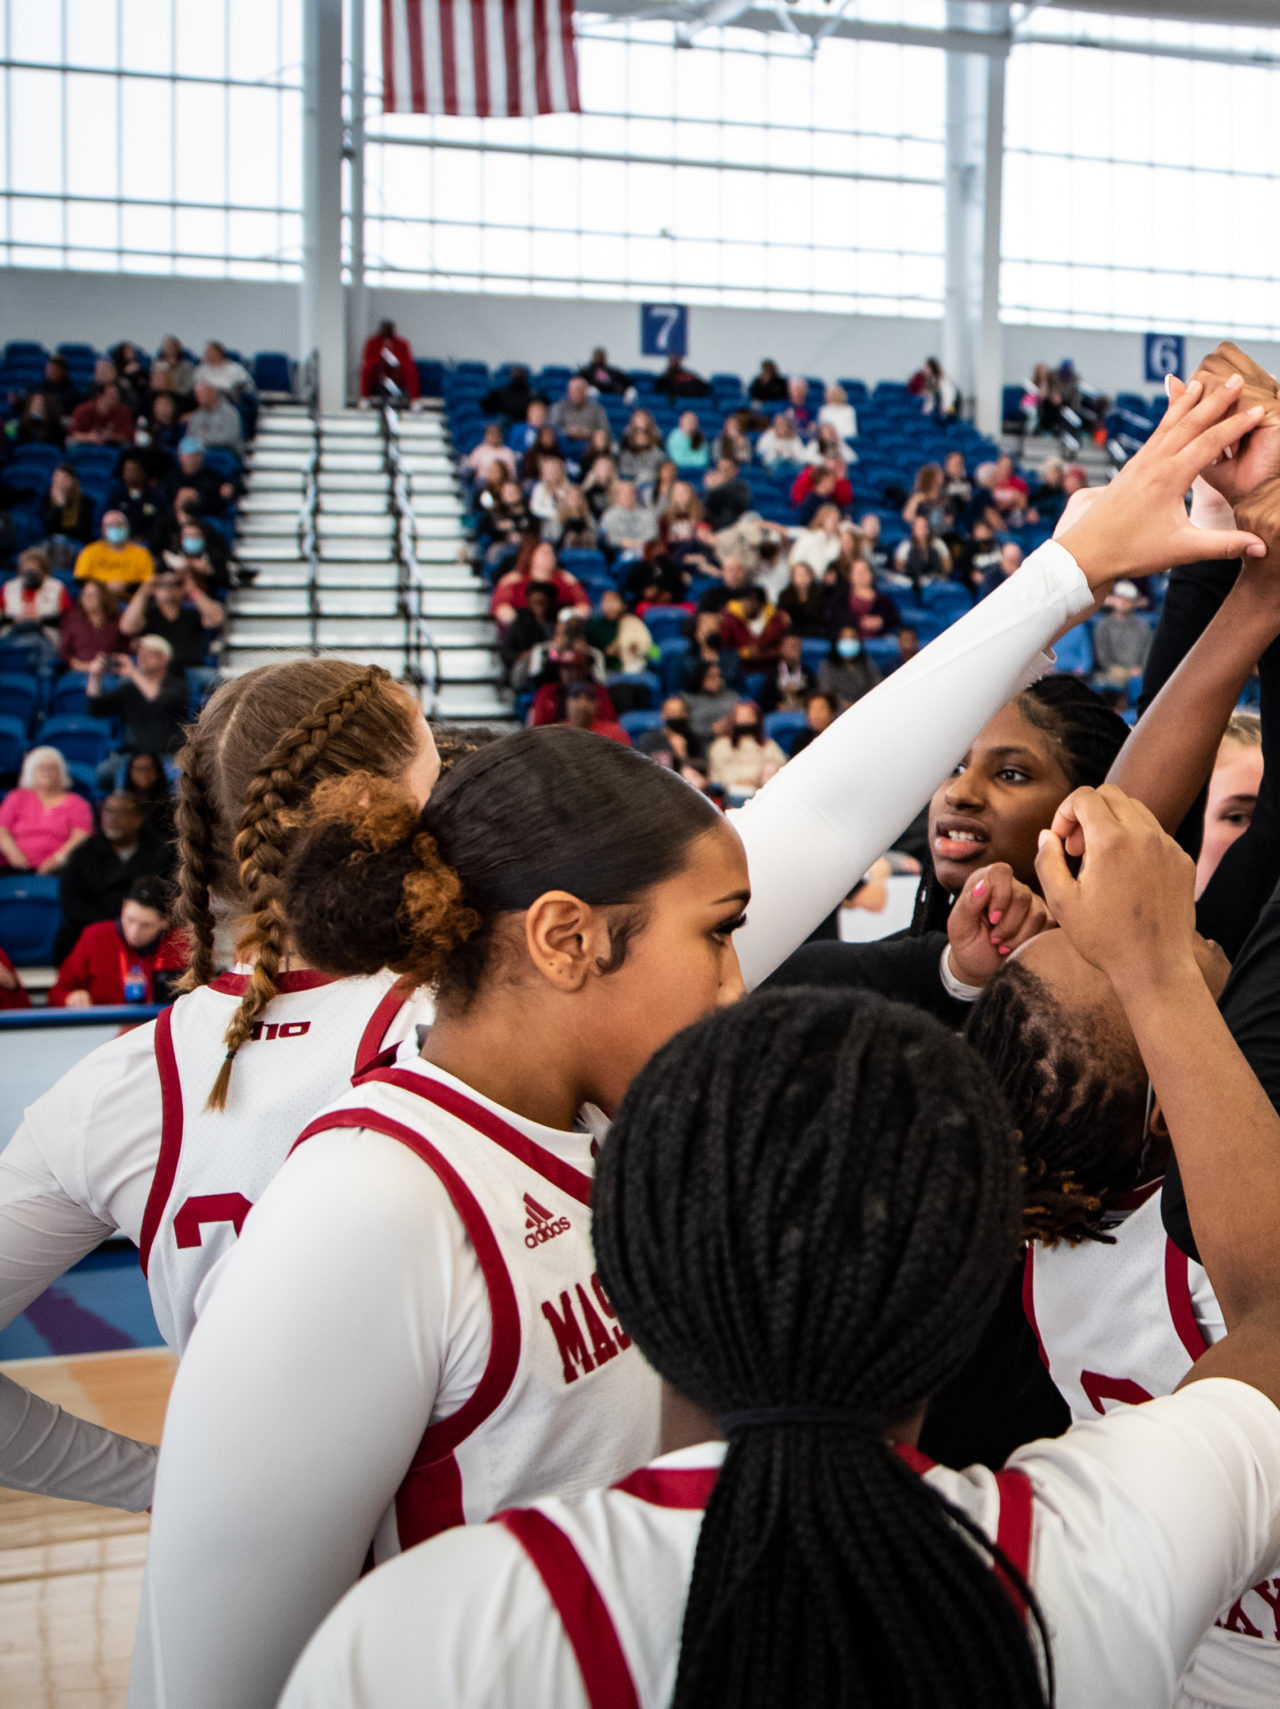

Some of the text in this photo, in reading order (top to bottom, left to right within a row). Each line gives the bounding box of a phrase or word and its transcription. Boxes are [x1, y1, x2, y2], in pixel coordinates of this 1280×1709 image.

[650, 306, 679, 348] 7
[1151, 337, 1178, 376] 6
[524, 1216, 572, 1249] adidas
